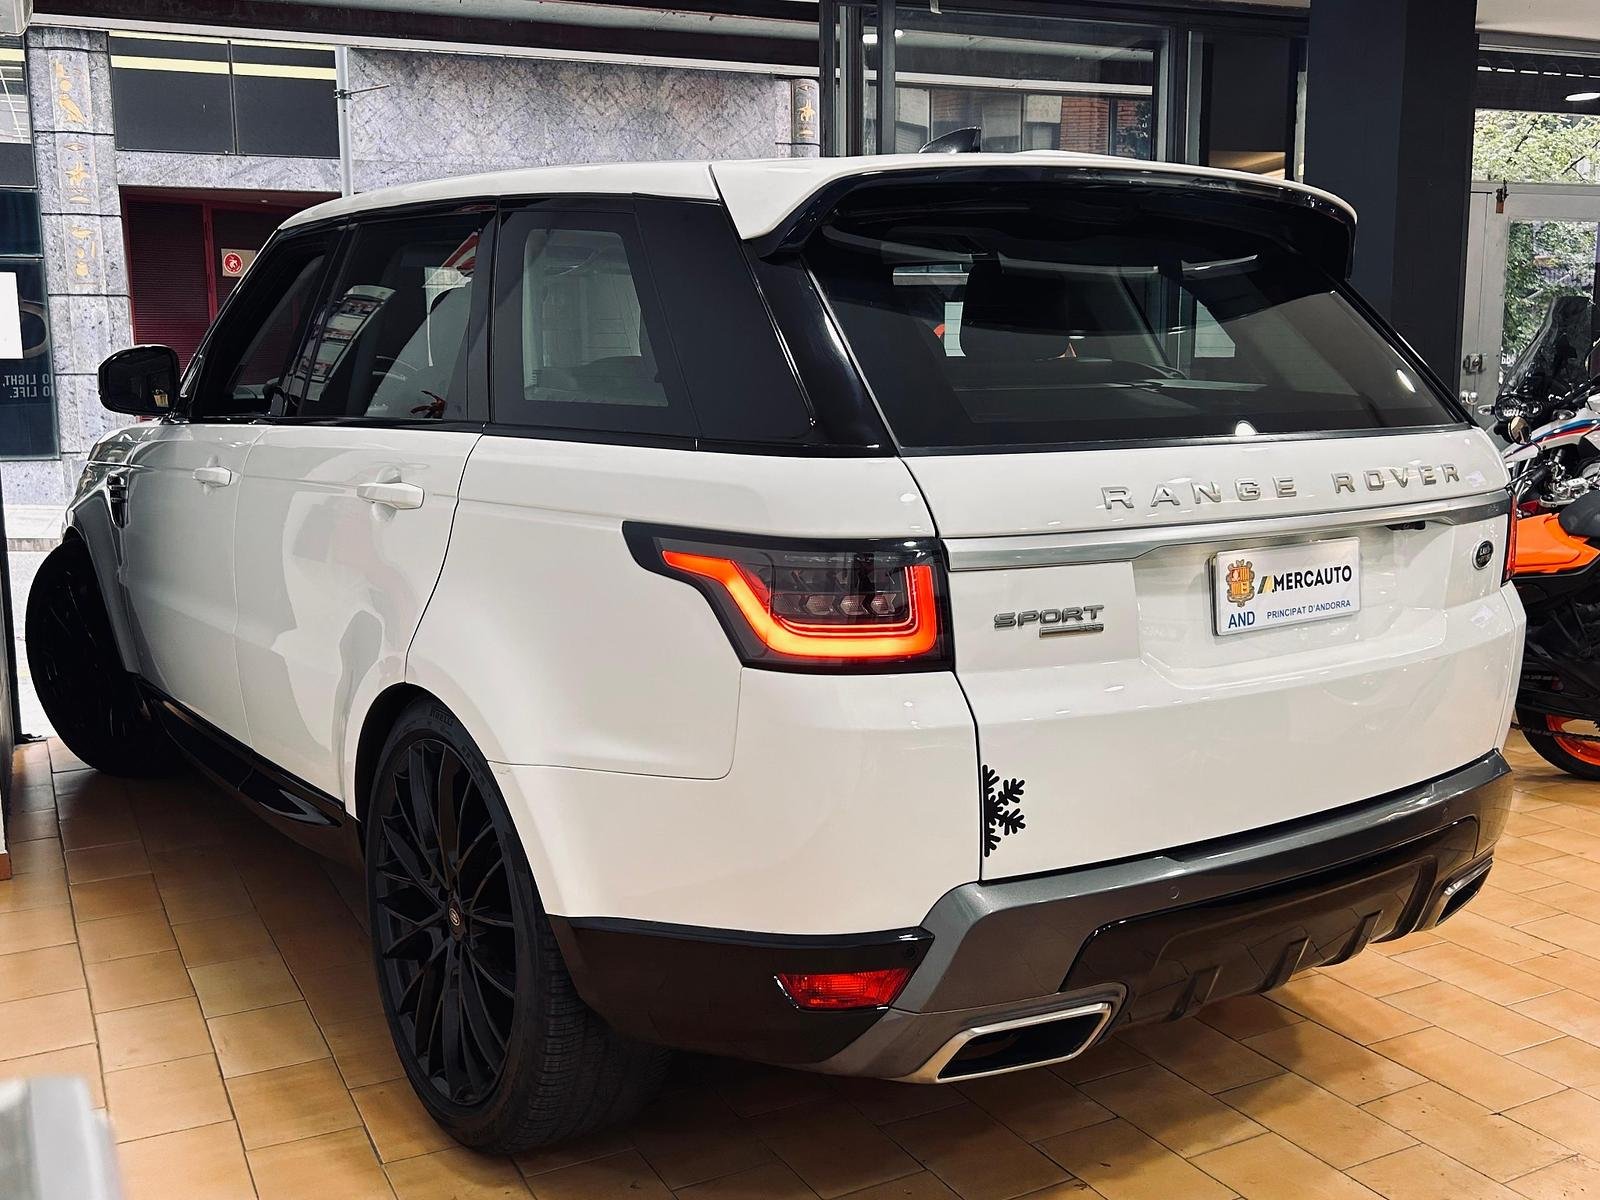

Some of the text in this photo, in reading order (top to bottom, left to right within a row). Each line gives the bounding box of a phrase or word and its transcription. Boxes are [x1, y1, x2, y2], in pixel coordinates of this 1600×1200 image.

[1101, 463, 1460, 510] RANGE ROVER
[1272, 565, 1352, 592] MERCAUTO
[993, 604, 1105, 629] SPORT
[1228, 611, 1256, 629] AND
[1266, 600, 1351, 620] PRINCIPAT D'ANDORRA
